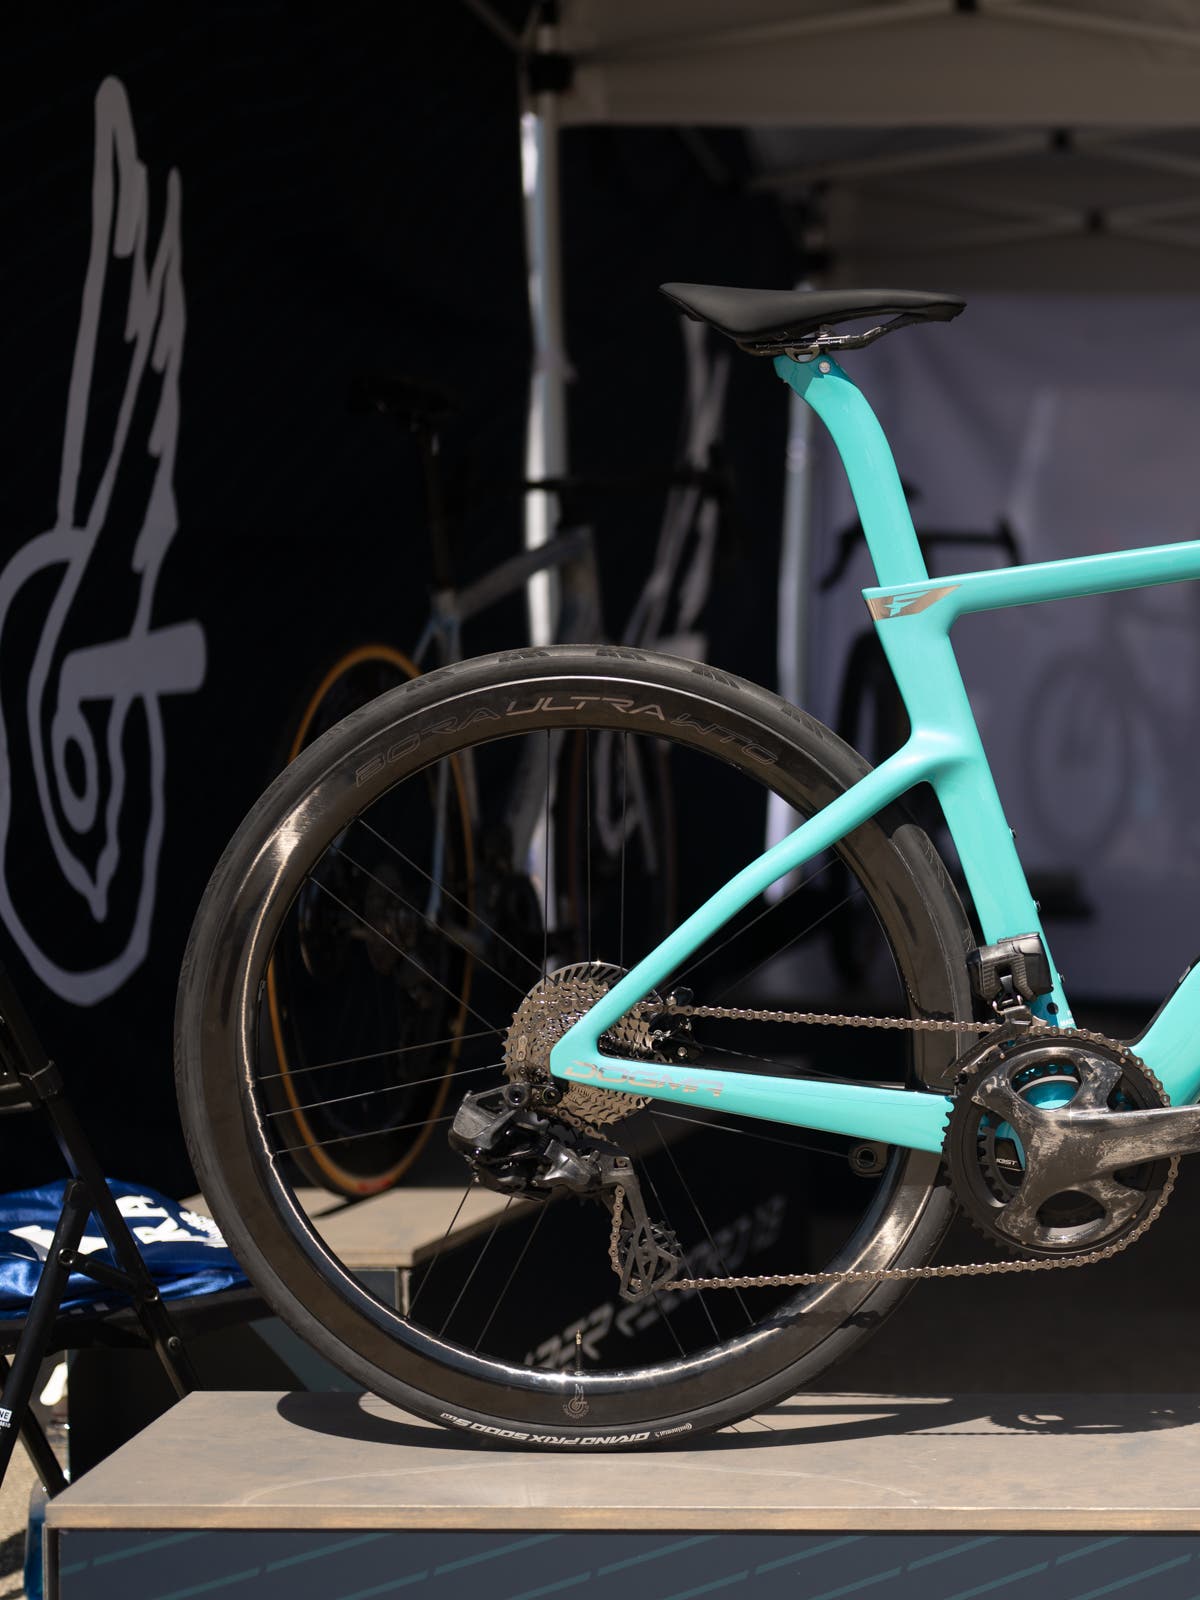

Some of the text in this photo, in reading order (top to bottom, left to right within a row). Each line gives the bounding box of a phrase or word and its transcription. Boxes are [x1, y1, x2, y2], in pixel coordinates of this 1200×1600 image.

[354, 695, 777, 788] BORA ULTRA WTO
[473, 1424, 531, 1440] 5000
[583, 1432, 650, 1445] GRAND
[532, 1434, 583, 1445] PRIX
